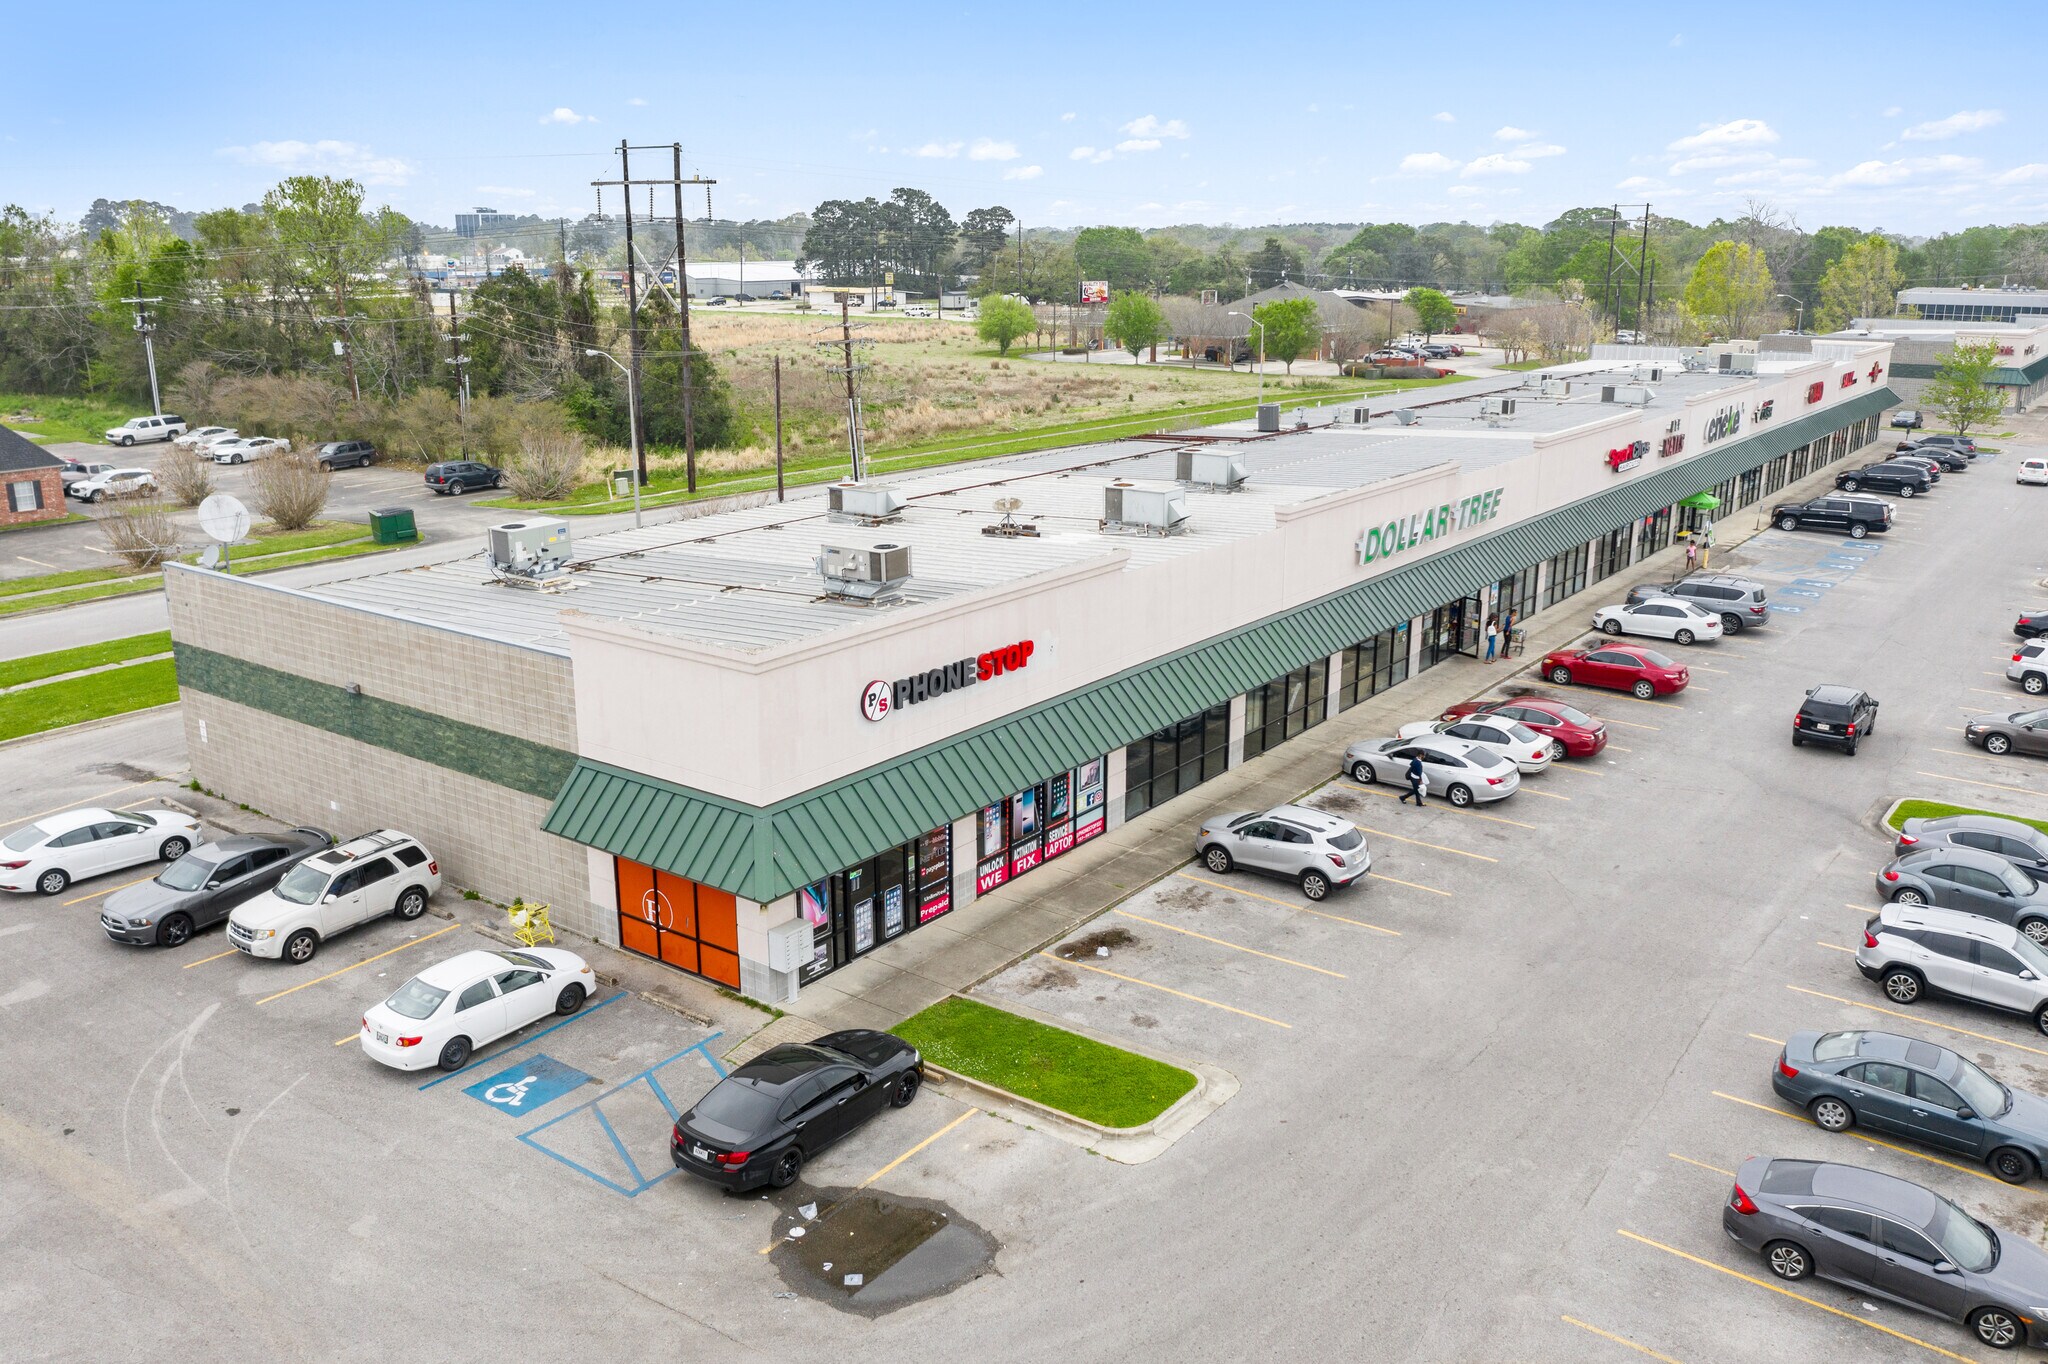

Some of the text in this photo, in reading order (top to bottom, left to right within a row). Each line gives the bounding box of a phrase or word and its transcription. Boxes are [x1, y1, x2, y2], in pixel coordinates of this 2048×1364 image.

[1359, 487, 1505, 566] DOLLAR TREE
[1048, 825, 1068, 843] SERVICE
[1044, 834, 1073, 858] LAPTOP
[979, 856, 1004, 877] UNLOCK
[1017, 853, 1036, 873] FIX
[980, 870, 1003, 890] WE
[920, 897, 949, 918] Prepaid
